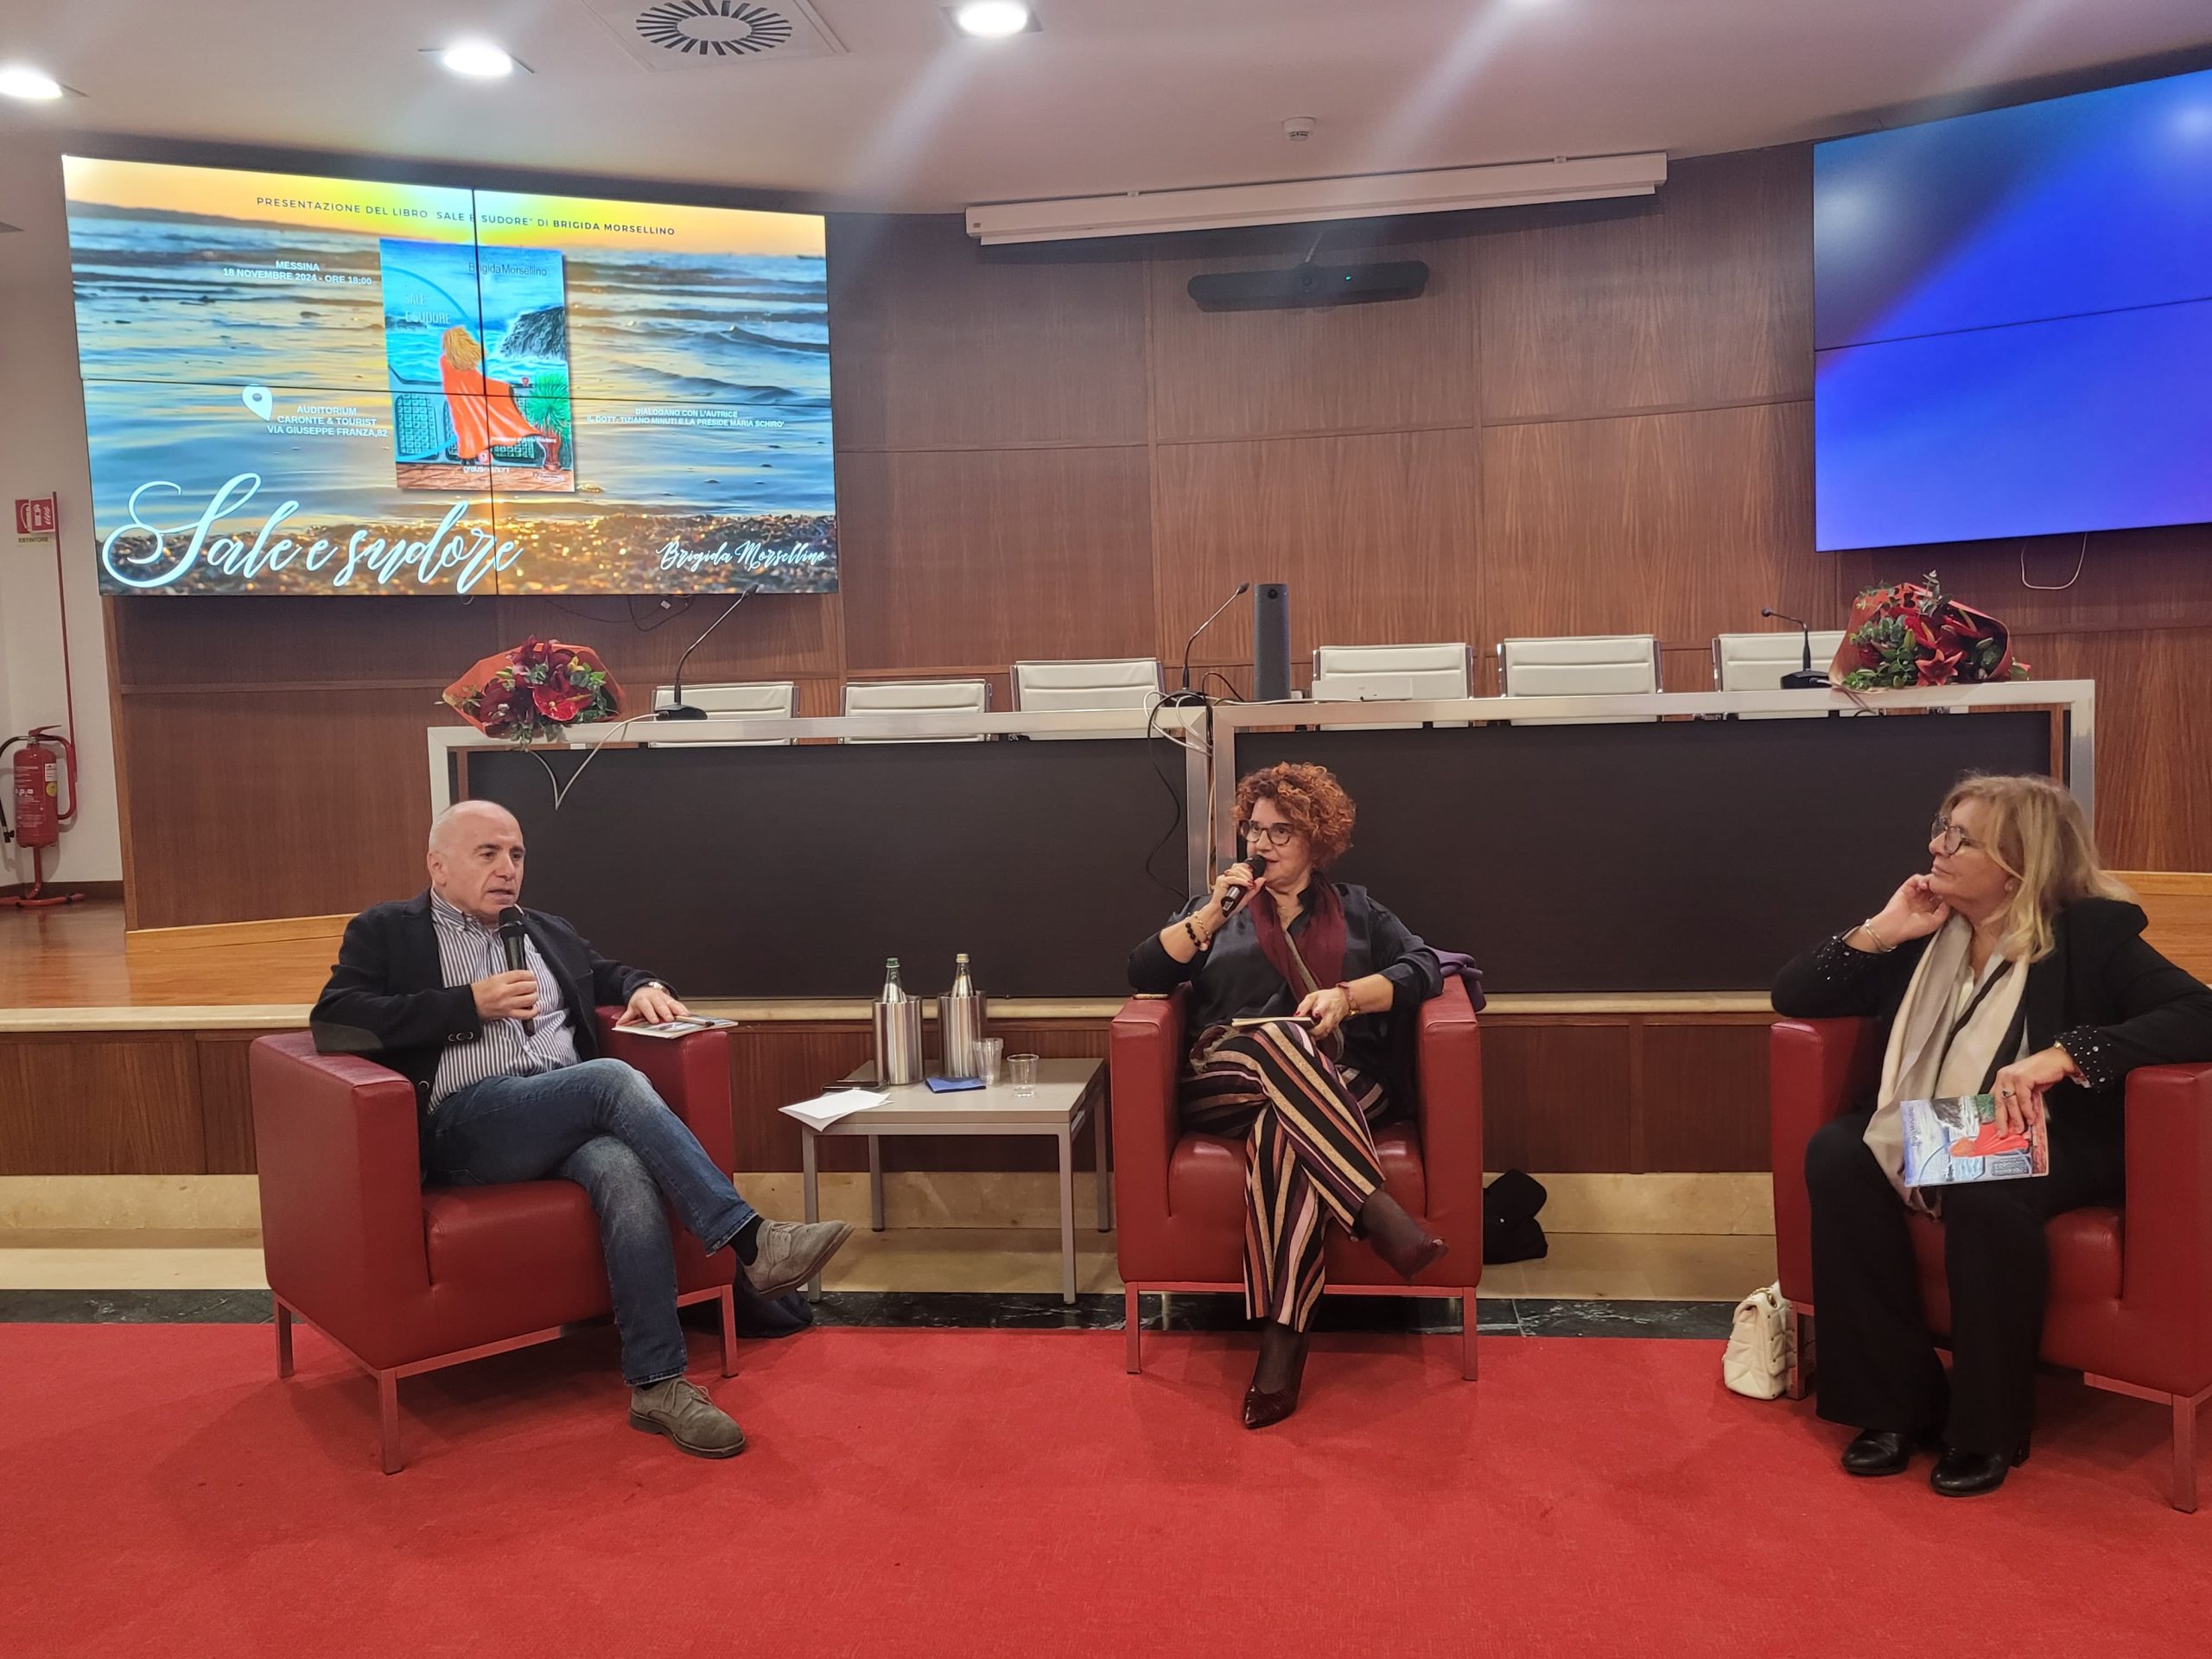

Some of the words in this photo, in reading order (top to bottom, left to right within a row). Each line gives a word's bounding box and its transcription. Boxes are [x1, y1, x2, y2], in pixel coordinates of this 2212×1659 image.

[257, 197, 361, 213] PRESENTAZIONE
[365, 206, 389, 215] DEL
[392, 208, 429, 218] LIBRO
[537, 219, 550, 227] DI
[553, 219, 601, 231] BRIGIDA
[604, 223, 676, 236] MORSELLINO
[275, 260, 321, 271] MESSINA
[222, 268, 235, 277] 18
[237, 270, 293, 281] NOVEMBRE
[296, 273, 317, 282] 2024
[325, 275, 346, 283] ORE
[347, 276, 372, 285] 18:00
[414, 312, 451, 325] SUDORE
[296, 405, 357, 416] AUDITORIUM
[635, 408, 681, 416] DIALOGANO
[276, 416, 325, 425] CARONTE
[327, 416, 334, 425] &
[335, 417, 378, 427] TOURIST
[620, 416, 650, 424] TIZIANO
[267, 425, 283, 434] VIA
[285, 426, 334, 435] GIUSEPPE
[102, 472, 302, 588] Sale
[307, 538, 342, 572] e
[333, 499, 524, 594] sudore
[655, 540, 734, 573] Brigida
[734, 539, 827, 572] Morsellino
